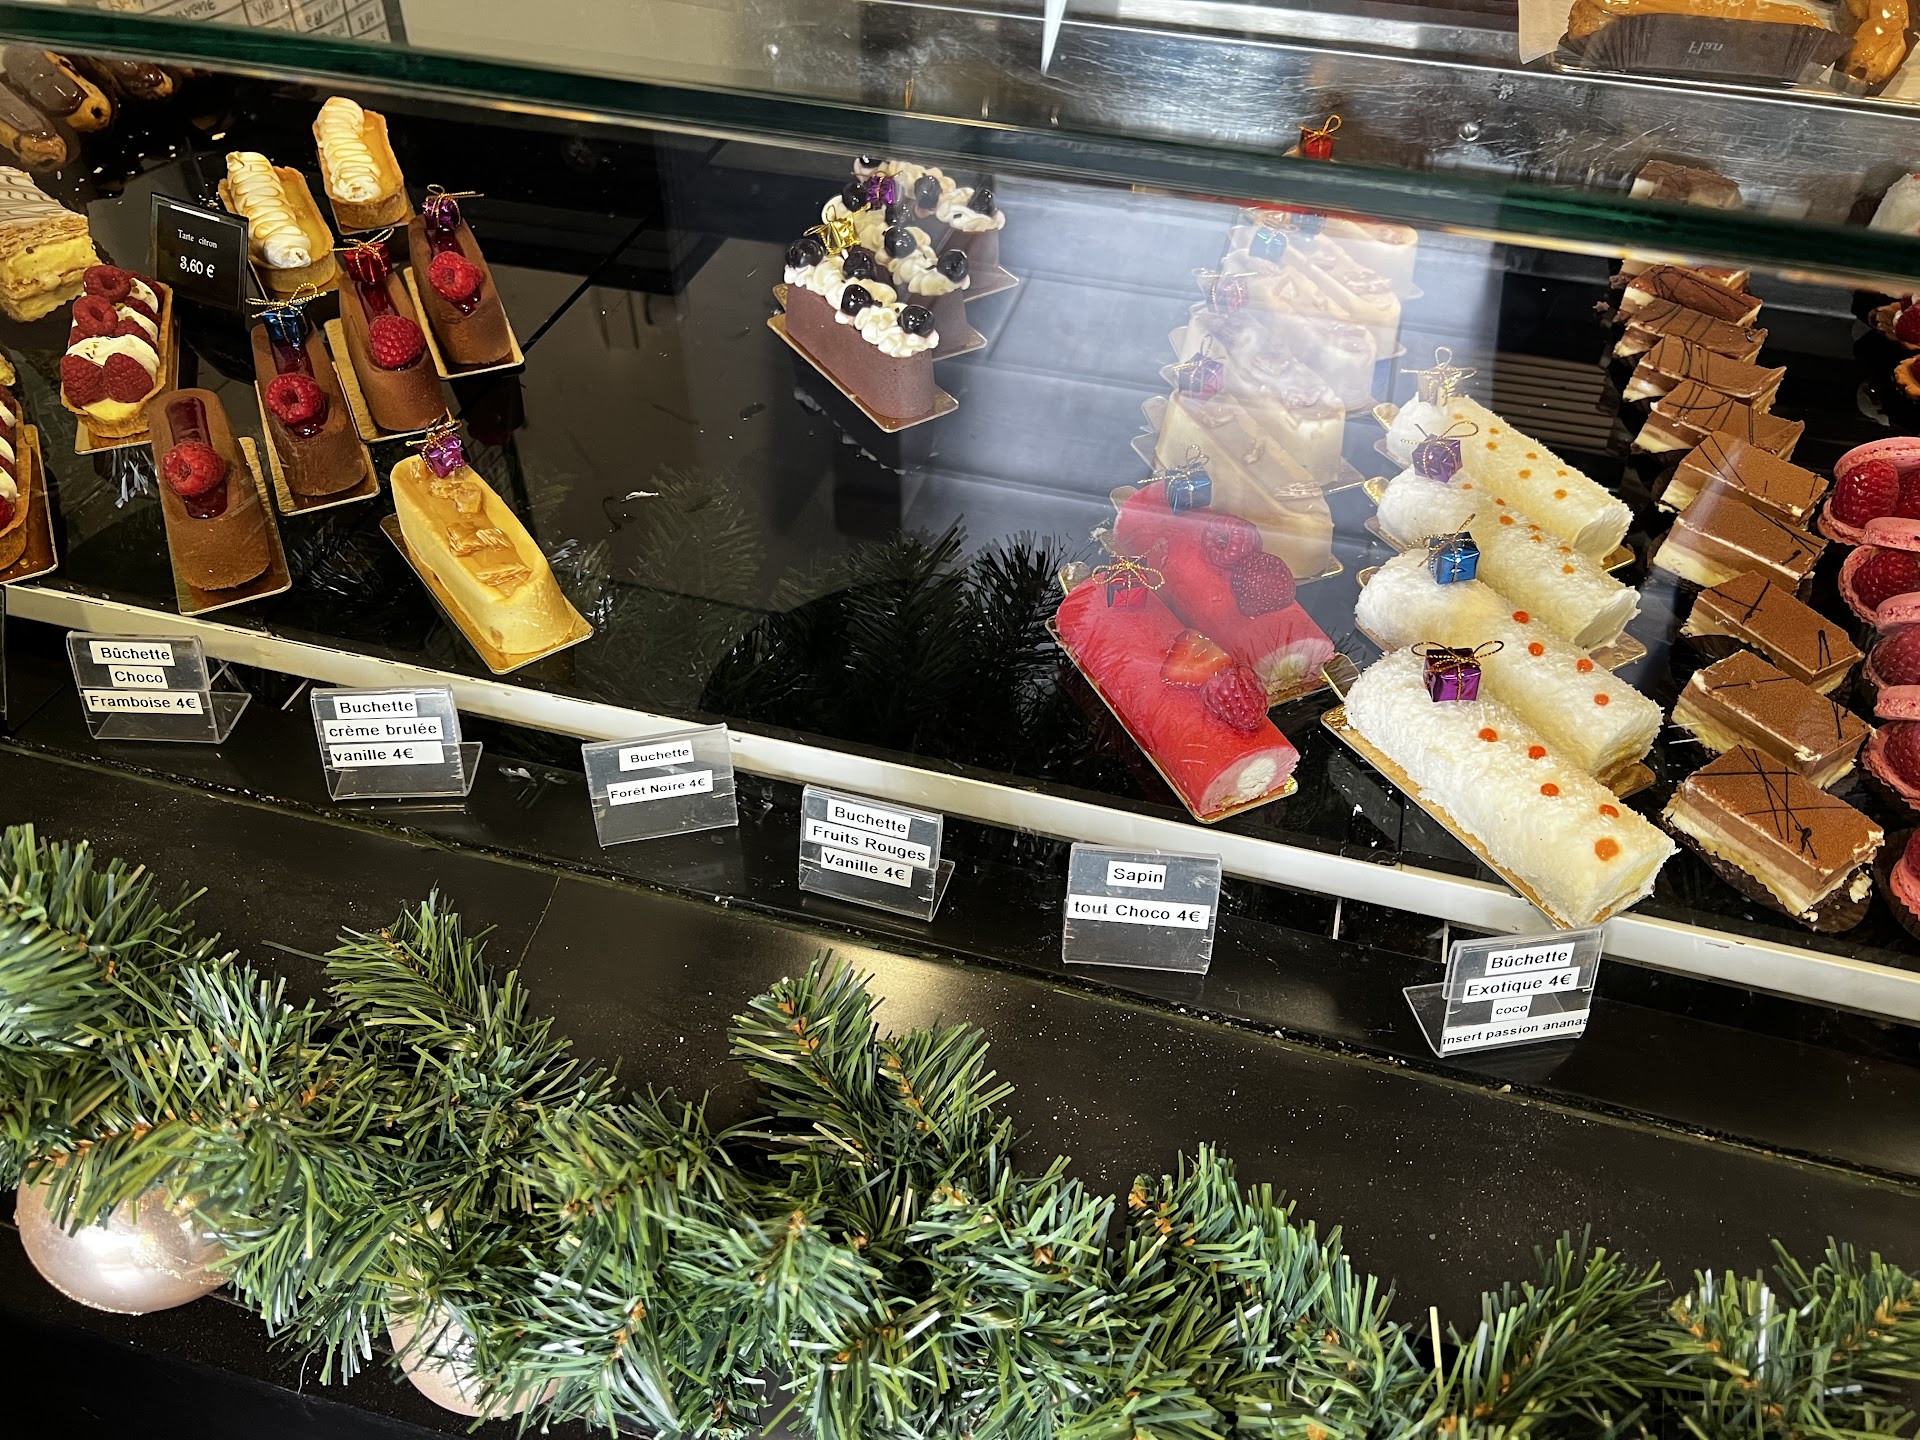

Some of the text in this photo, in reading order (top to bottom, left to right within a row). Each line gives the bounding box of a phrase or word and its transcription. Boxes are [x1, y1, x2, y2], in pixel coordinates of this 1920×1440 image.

[177, 229, 218, 249] Tarte citron
[179, 255, 215, 278] 3,60 €
[100, 646, 170, 661] Bûchette
[114, 670, 163, 683] Choco
[89, 695, 196, 709] Framboise 4€
[339, 700, 414, 714] Buchette
[329, 723, 437, 737] crème brulée
[332, 747, 414, 762] vanille 4€
[630, 748, 690, 763] Buchette
[610, 777, 706, 799] Forêt Noire 4€
[835, 806, 906, 833] Buchette
[813, 825, 926, 861] Fruits Rouges
[824, 852, 906, 880] Vanille 4€
[1113, 867, 1163, 884] Sapin
[1074, 901, 1201, 923] tout Choco 4€
[1491, 950, 1568, 969] Bûchette
[1467, 973, 1572, 996] Exotique 4€
[1495, 1004, 1528, 1015] coco
[1443, 1017, 1589, 1045] insert passion ananas
